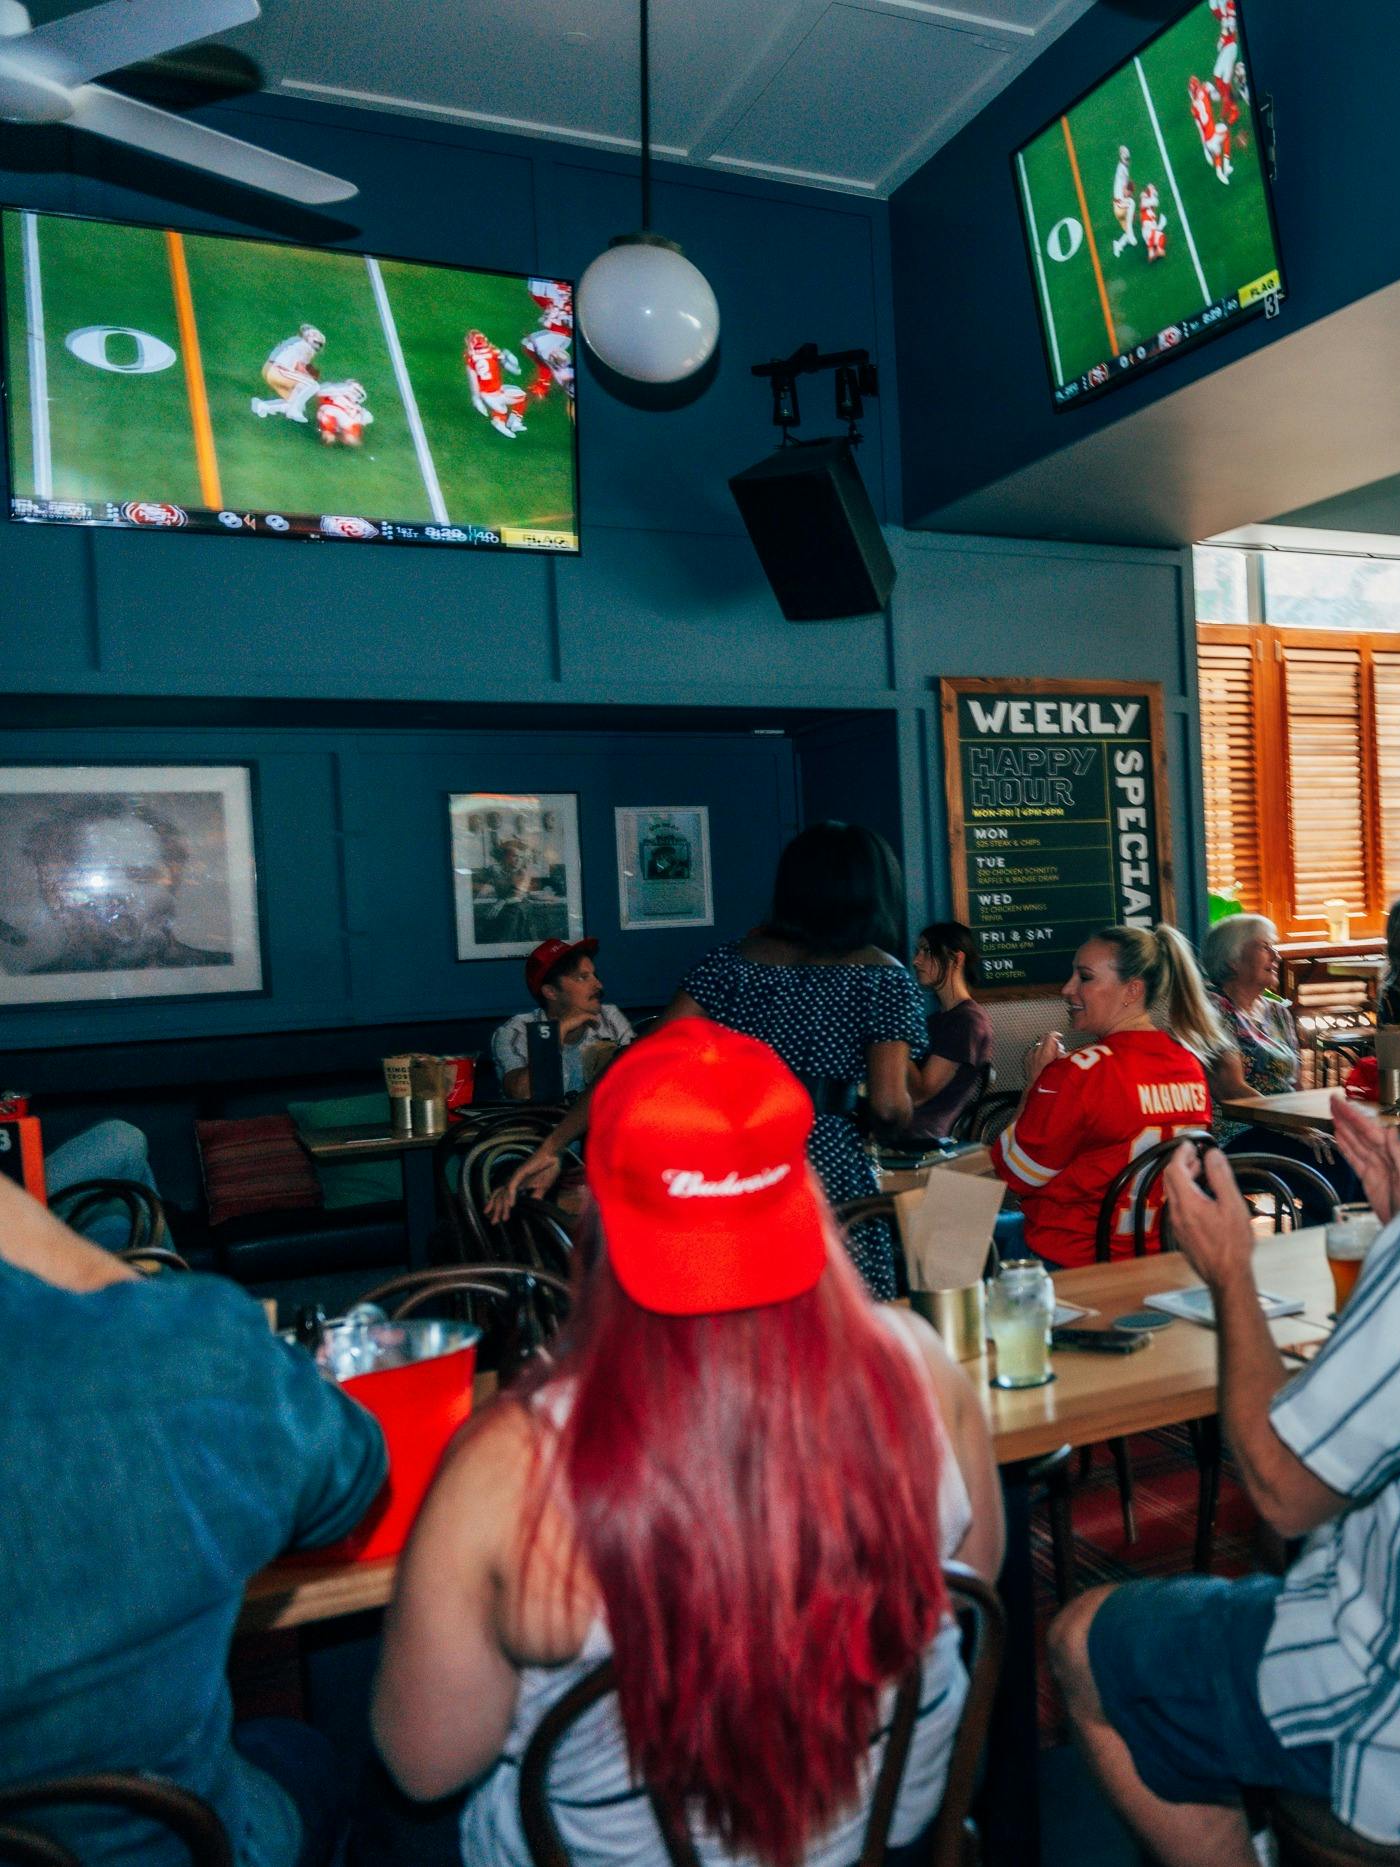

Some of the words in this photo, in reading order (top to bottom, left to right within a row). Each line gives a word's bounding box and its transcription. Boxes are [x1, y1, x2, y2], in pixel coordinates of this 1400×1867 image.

[1266, 293, 1276, 316] 3
[967, 700, 1141, 735] WEEKLY
[969, 746, 1097, 777] HAPPY
[971, 777, 1075, 807] HOUR
[974, 827, 1009, 839] MON
[1113, 749, 1153, 928] SPECIAL
[976, 857, 1006, 868] TUE
[978, 894, 1012, 906] WED
[980, 931, 1006, 943] FRI
[1011, 930, 1021, 942] &
[1026, 927, 1054, 941] SAT
[983, 959, 1014, 971] SUN
[540, 1026, 551, 1039] 5
